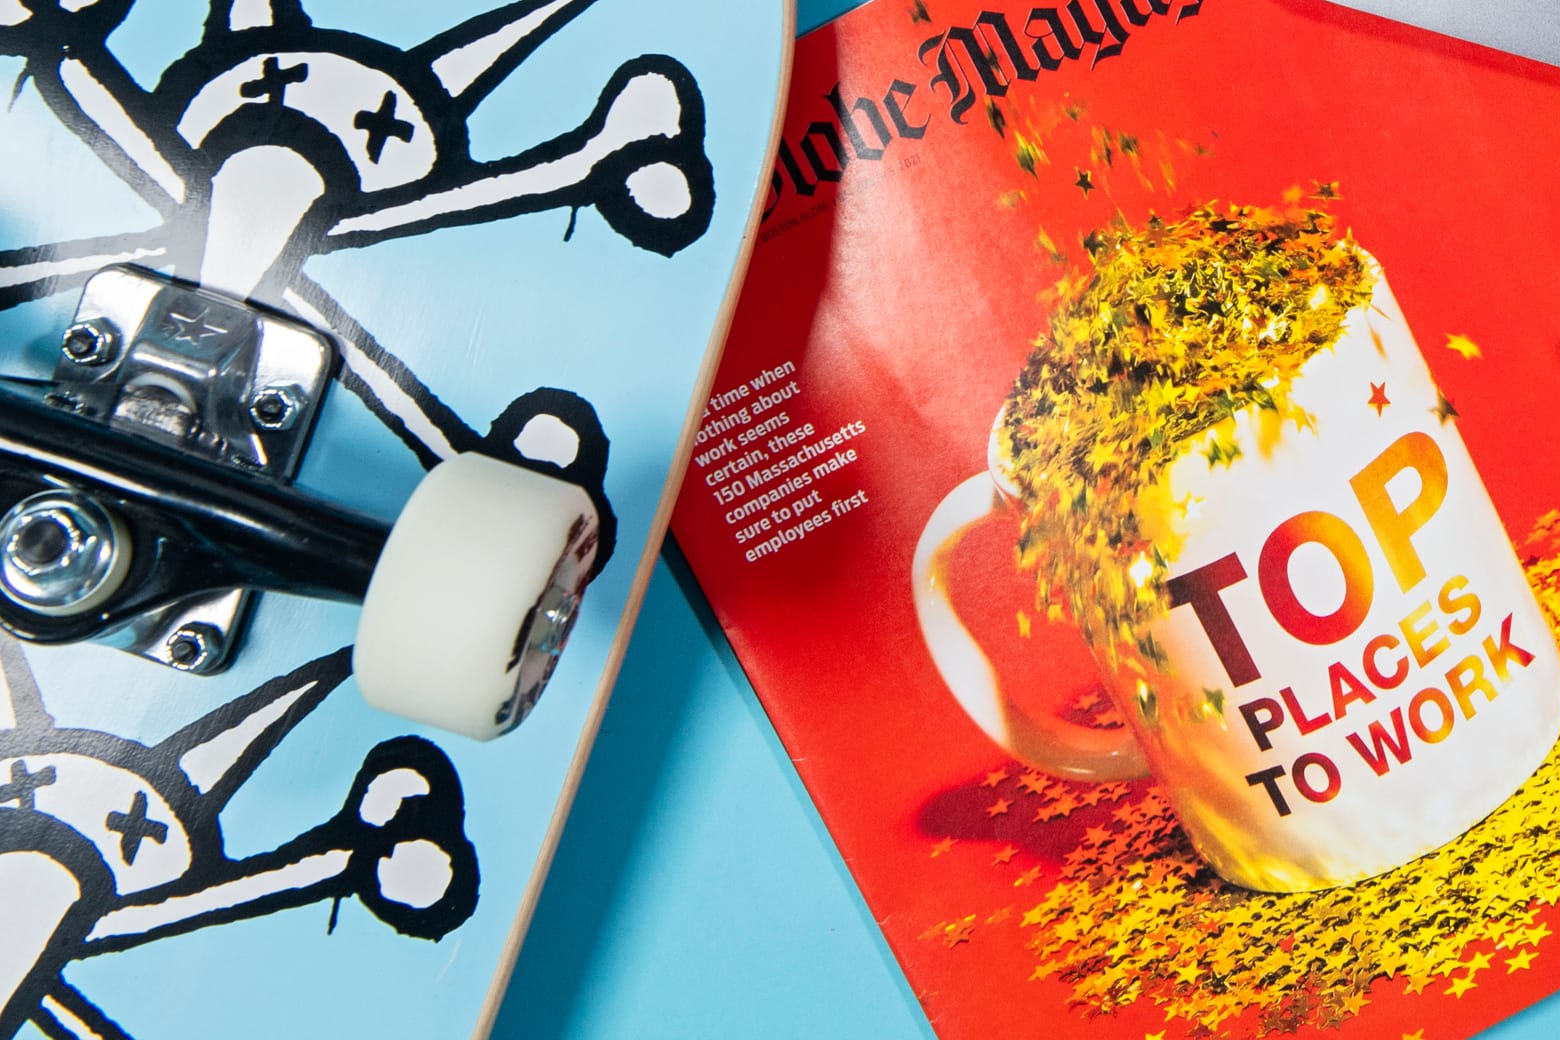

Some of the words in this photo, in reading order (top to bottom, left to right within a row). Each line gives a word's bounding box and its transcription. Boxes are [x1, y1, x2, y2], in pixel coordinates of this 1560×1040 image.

[694, 407, 752, 447] othing
[751, 380, 801, 415] about
[710, 384, 750, 411] time
[750, 360, 796, 391] when
[695, 438, 738, 468] work
[737, 411, 790, 447] seems
[705, 448, 769, 487] certain,
[767, 422, 815, 454] these
[713, 480, 746, 506] 150
[745, 419, 867, 490] Massachusetts
[725, 472, 813, 525] companies
[812, 448, 858, 480] make
[735, 517, 772, 544] sure
[771, 507, 791, 524] to
[792, 489, 823, 517] put
[745, 509, 833, 563] employees
[831, 489, 869, 518] first
[1166, 431, 1448, 688] TOP
[1238, 574, 1482, 752] PLACES
[1245, 752, 1341, 817] TO
[1346, 612, 1536, 777] WORK
